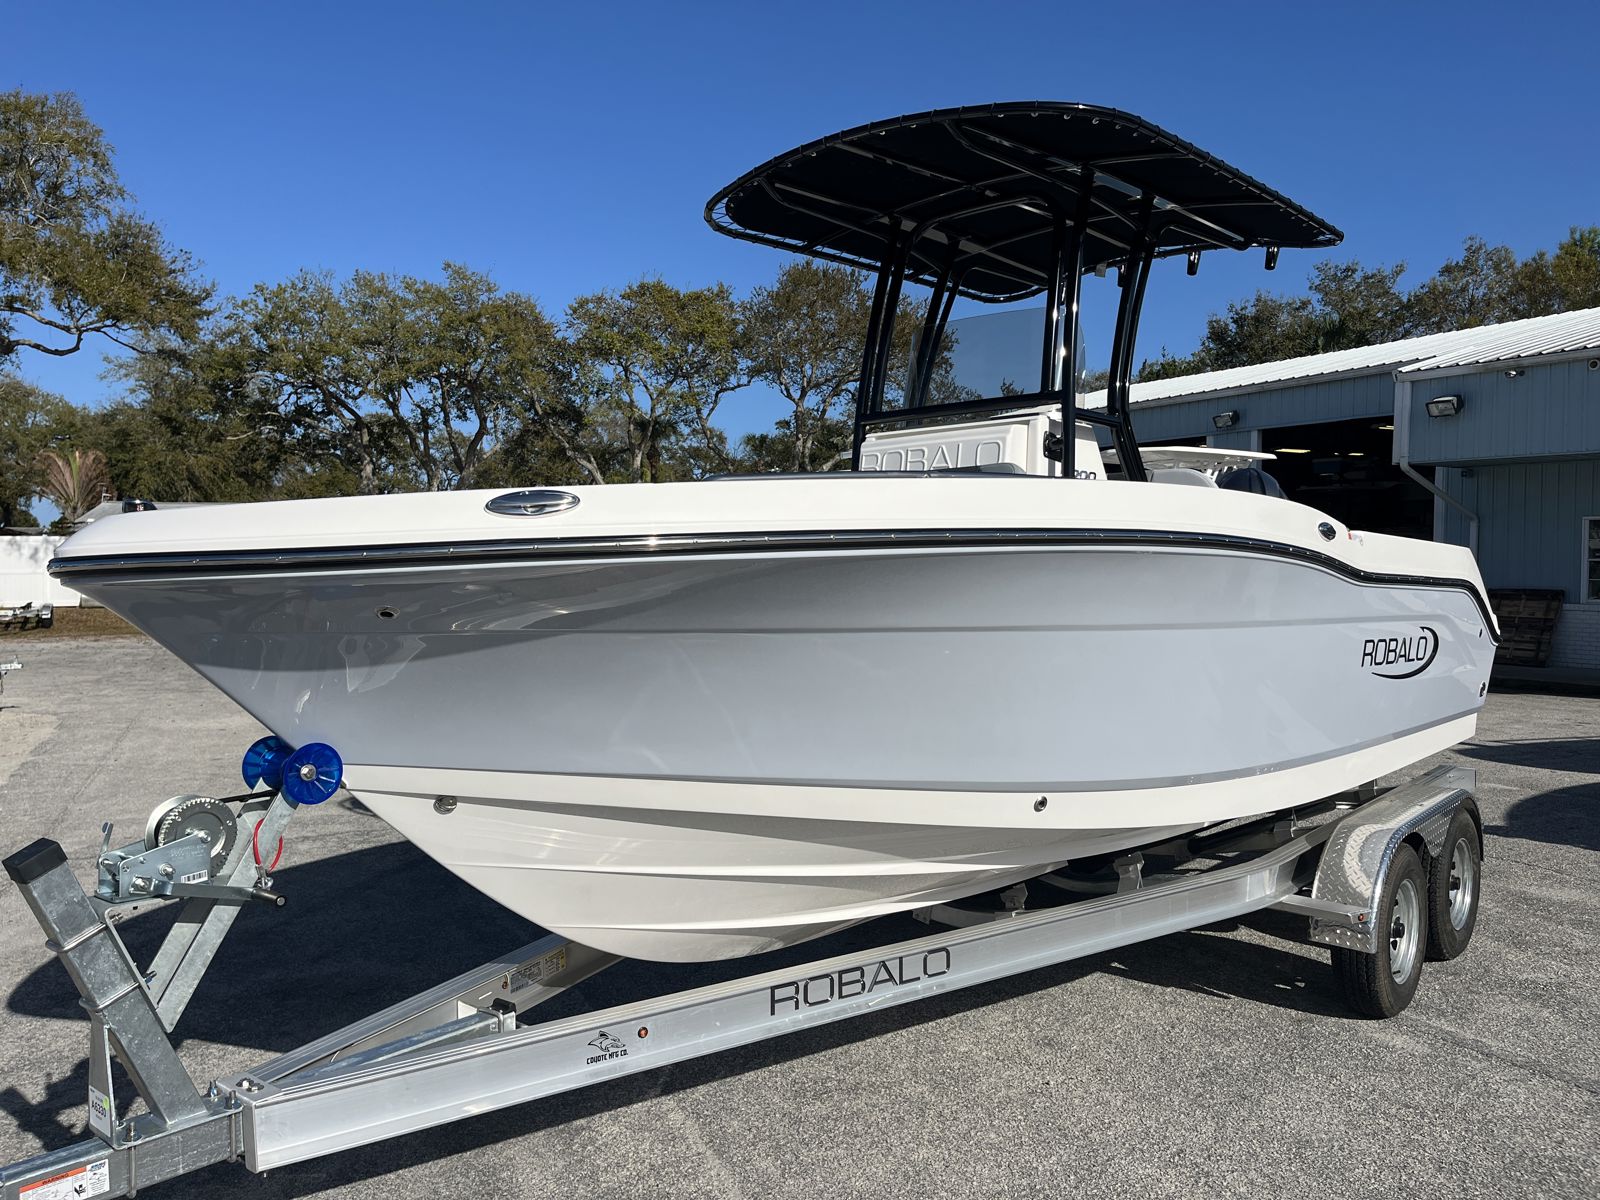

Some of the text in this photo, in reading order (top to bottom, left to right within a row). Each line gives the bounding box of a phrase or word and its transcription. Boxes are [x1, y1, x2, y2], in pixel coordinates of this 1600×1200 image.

[1361, 636, 1428, 667] ROBALO
[769, 946, 951, 1017] ROBALO
[586, 1053, 607, 1065] COYOTE
